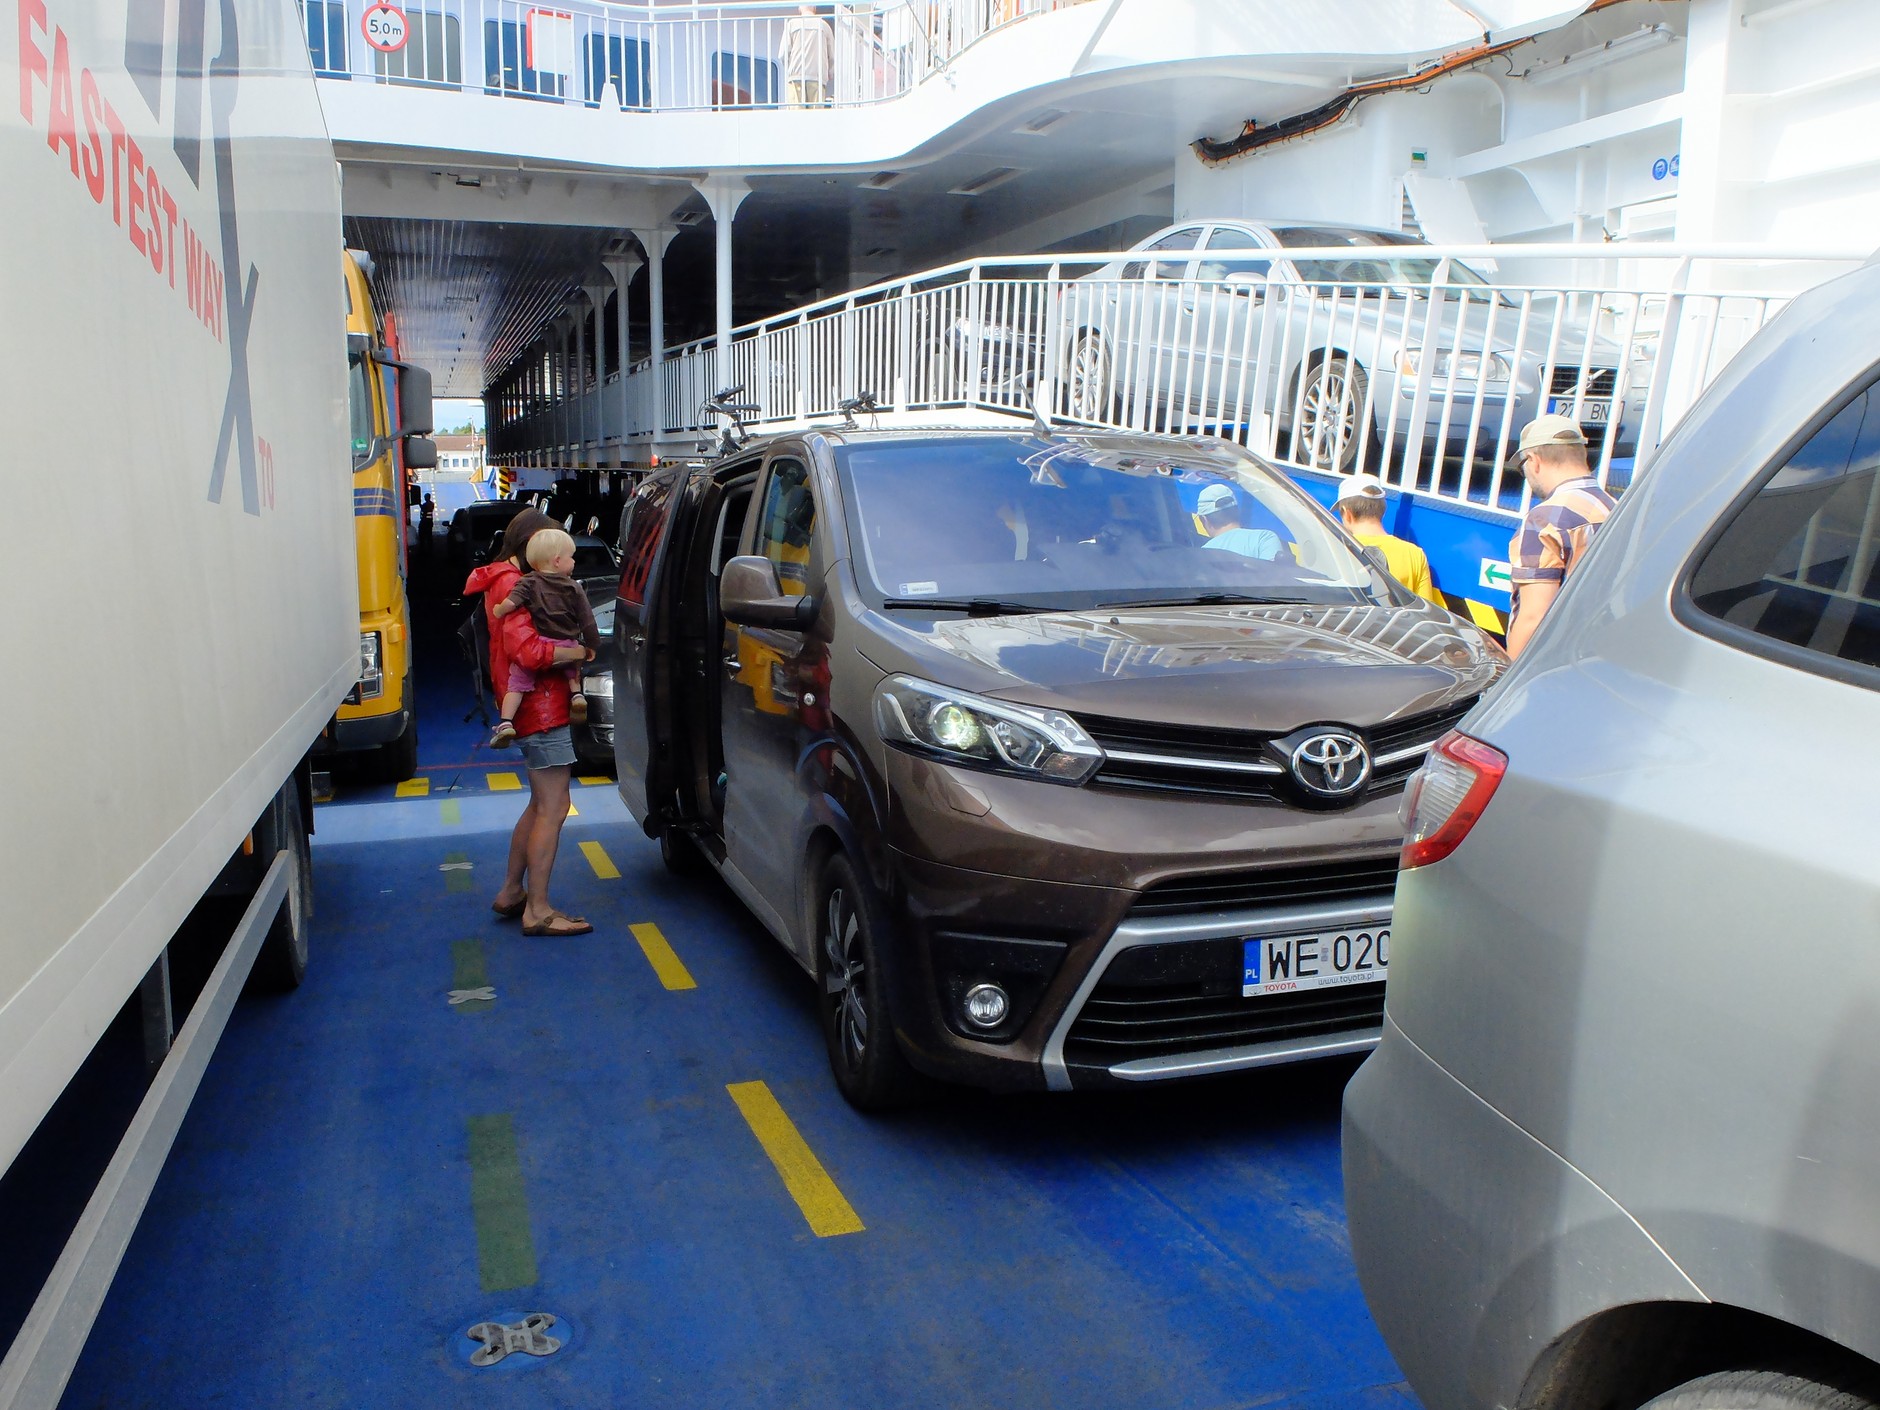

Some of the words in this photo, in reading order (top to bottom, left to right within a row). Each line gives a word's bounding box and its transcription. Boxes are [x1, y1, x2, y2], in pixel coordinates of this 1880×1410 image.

[17, 0, 178, 291] FASTEST
[183, 217, 223, 344] WAY
[258, 436, 274, 511] TO
[1559, 402, 1585, 418] 27
[1590, 404, 1611, 420] BN
[1268, 938, 1319, 980] WE
[1245, 968, 1258, 980] PL
[1318, 971, 1375, 987] www.toyota.pl
[1264, 982, 1297, 993] TOYOTA
